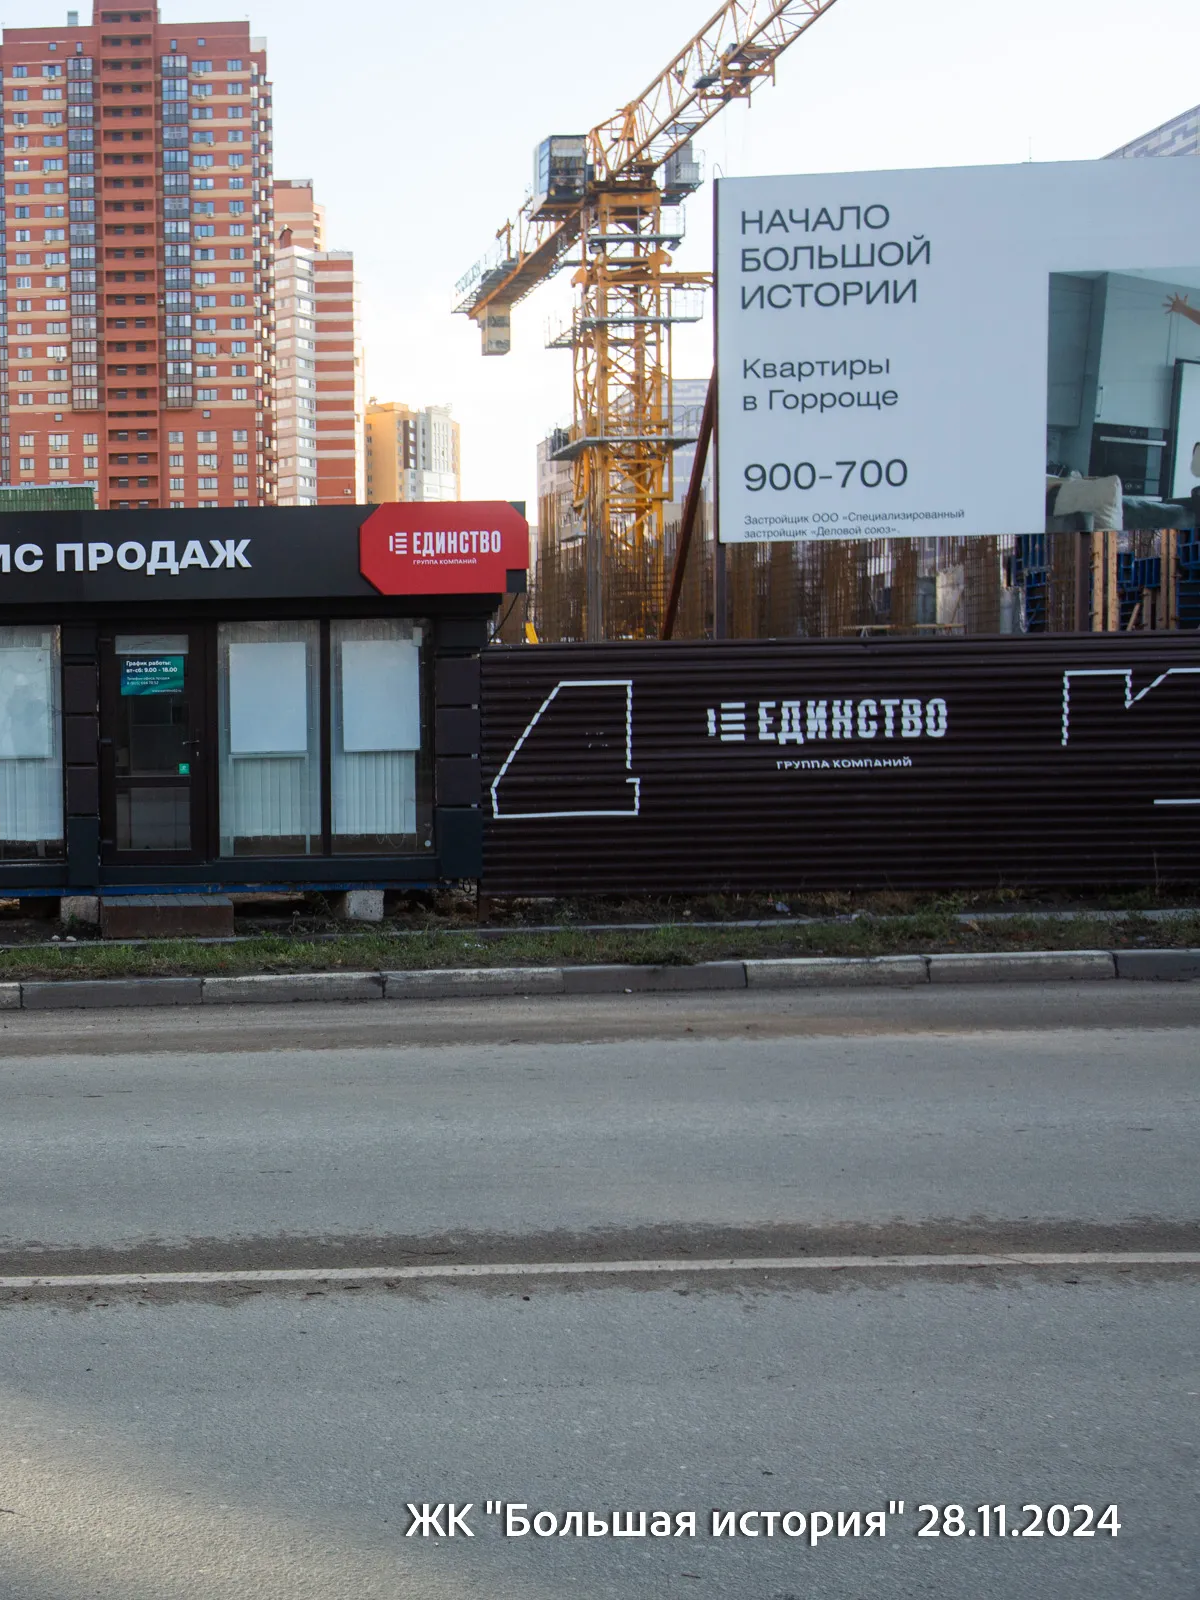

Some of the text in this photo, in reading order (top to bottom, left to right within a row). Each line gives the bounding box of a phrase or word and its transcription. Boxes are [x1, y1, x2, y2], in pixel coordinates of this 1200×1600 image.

[741, 204, 890, 235] НАЧАЛО
[741, 234, 931, 272] БОЛЬШОЙ
[741, 279, 917, 310] ИСТОРИИ
[743, 358, 890, 382] Квартиры
[743, 389, 899, 414] в Горроще
[743, 458, 908, 491] 900-700
[743, 509, 965, 527] Застройщик ООО «Специализированный
[743, 527, 807, 540] застройщик
[810, 525, 862, 538] «Деловой
[56, 539, 252, 575] ПРОДАЖ
[412, 530, 501, 557] ЕДИНСТВО
[758, 698, 948, 745] ЕДИНСТВО
[776, 756, 912, 770] ГРУППА КОМПАНИЙ
